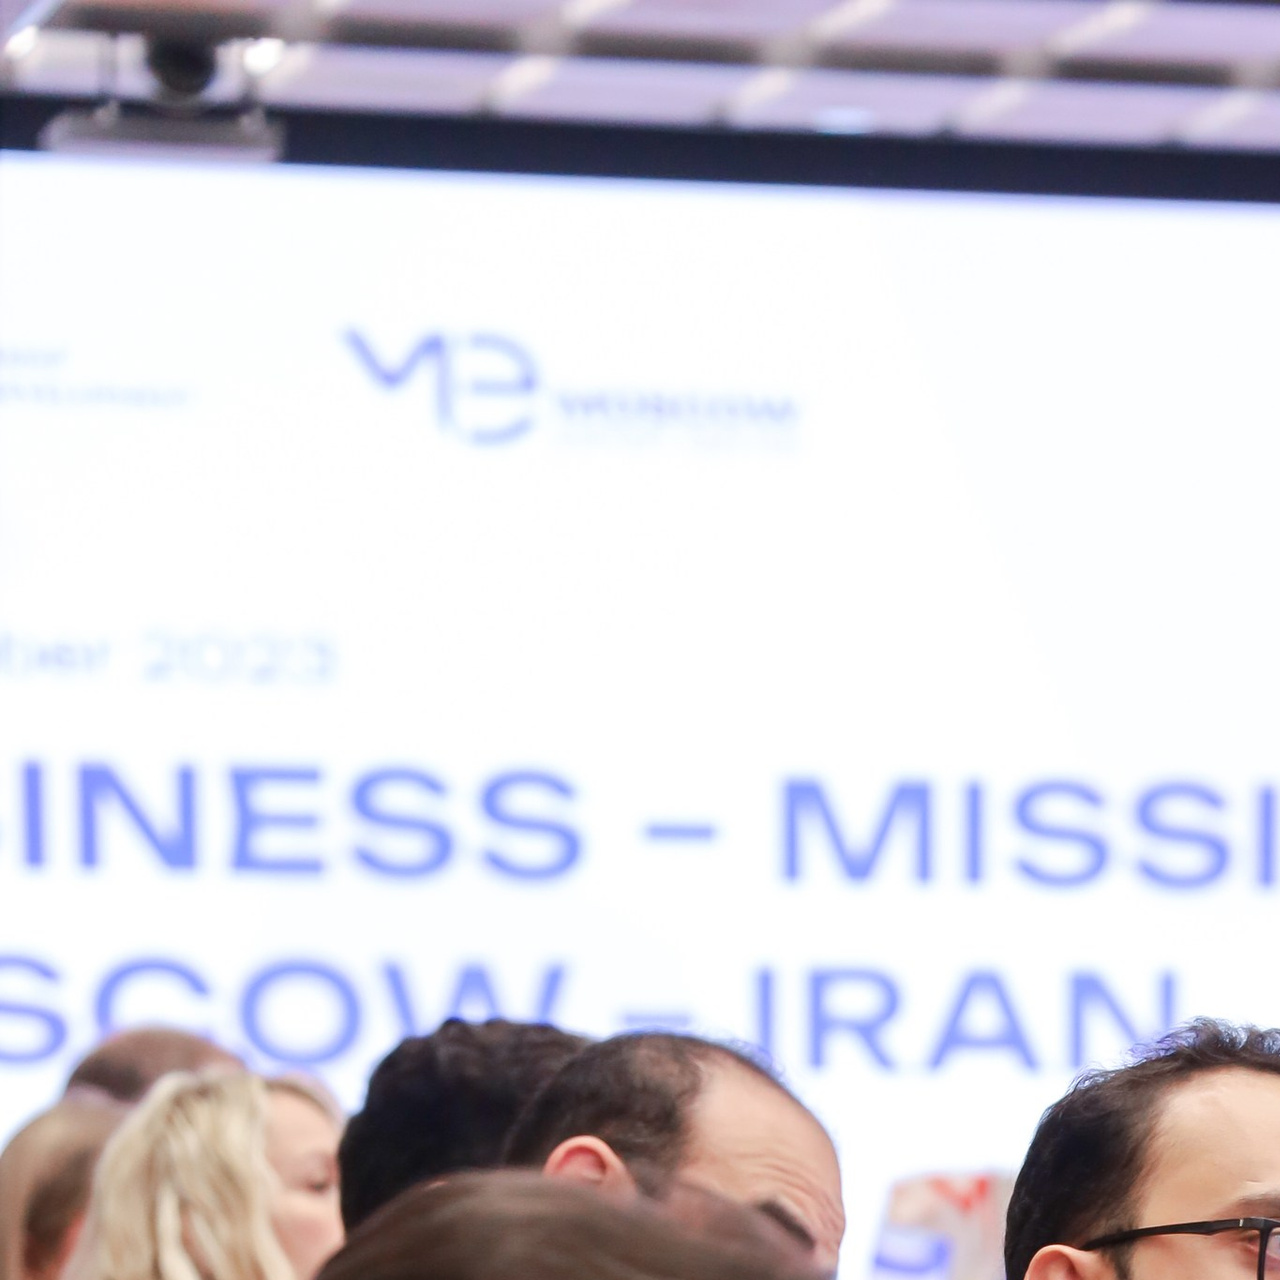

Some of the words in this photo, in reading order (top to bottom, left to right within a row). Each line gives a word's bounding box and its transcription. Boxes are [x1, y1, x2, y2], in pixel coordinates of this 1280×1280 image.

[142, 629, 341, 688] 2023
[0, 761, 583, 883] INESS
[0, 954, 566, 1065] SCOW
[752, 966, 1176, 1071] IRAN
